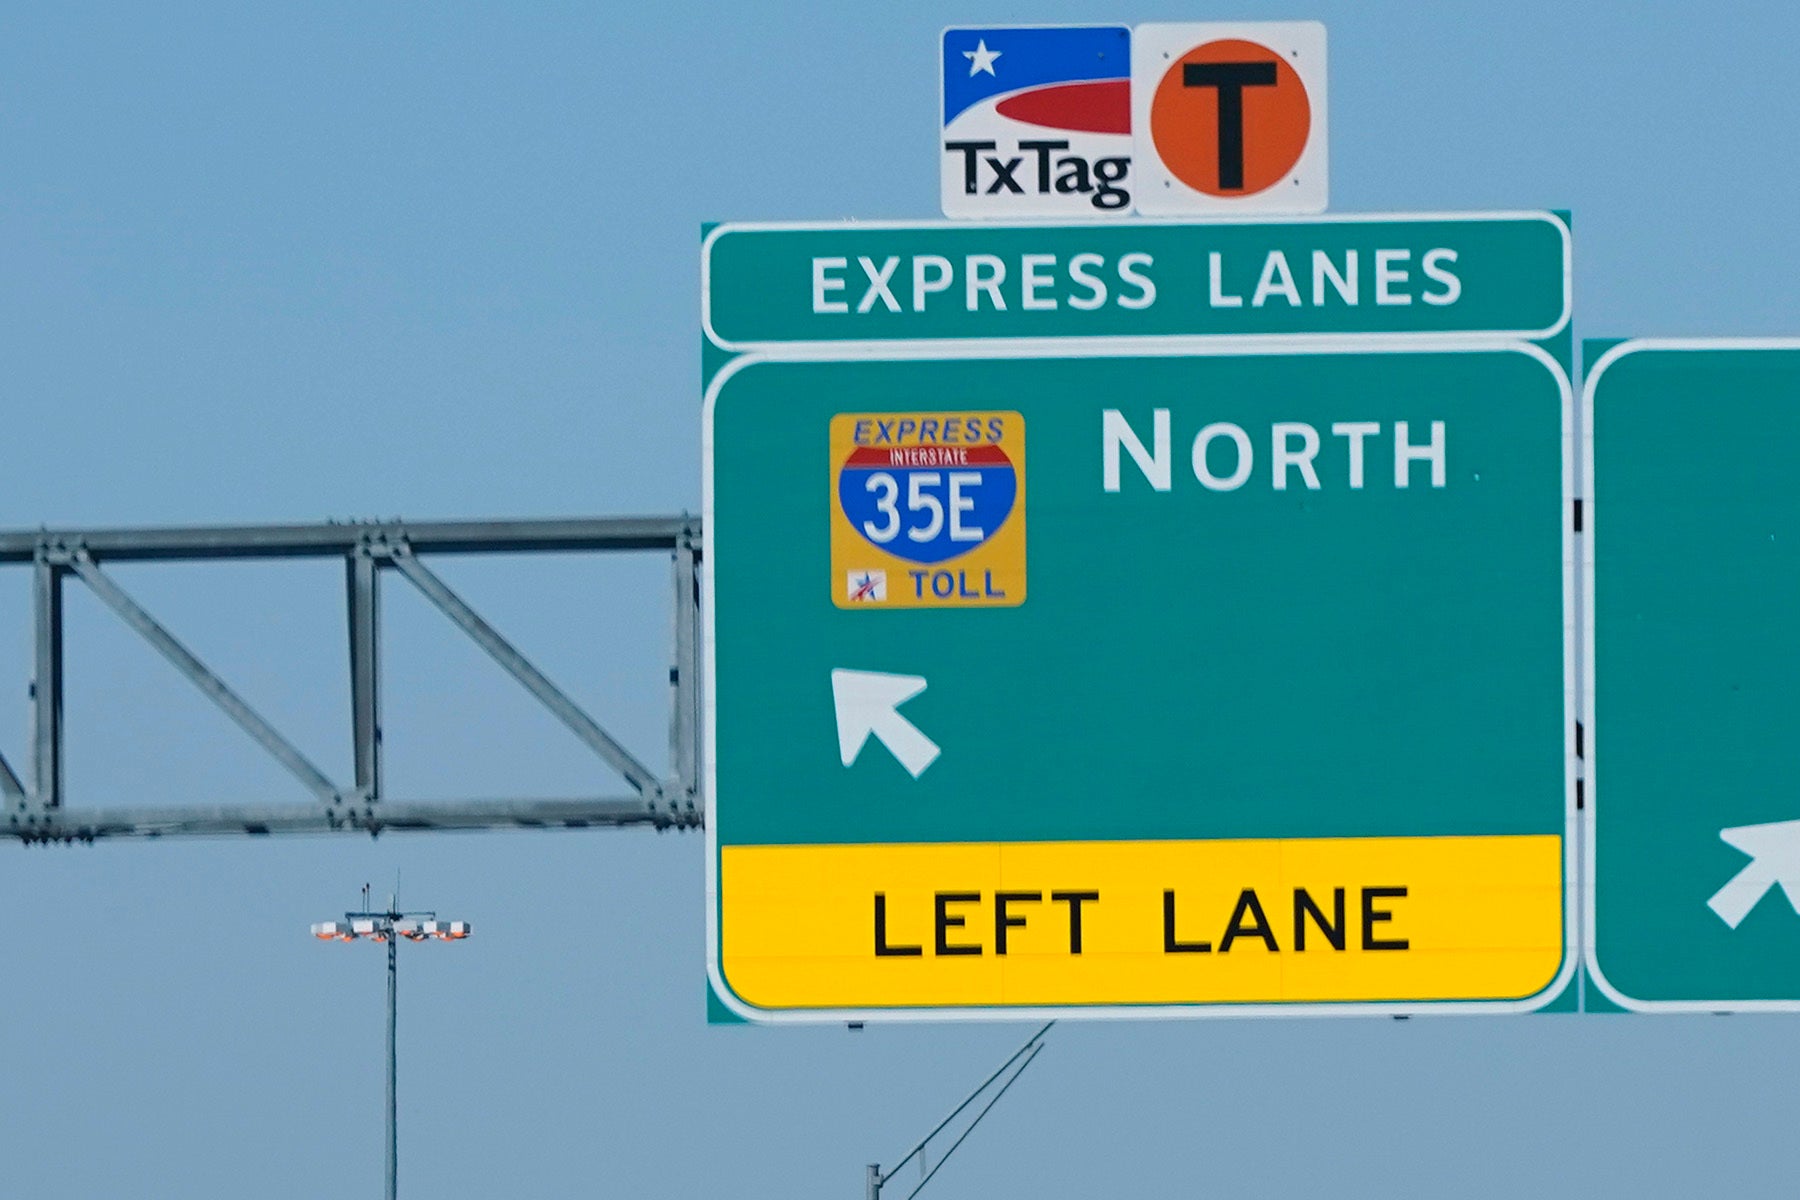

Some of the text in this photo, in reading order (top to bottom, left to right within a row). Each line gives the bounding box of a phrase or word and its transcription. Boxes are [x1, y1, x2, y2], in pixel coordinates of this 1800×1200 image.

[1182, 61, 1278, 190] T
[944, 139, 1132, 210] TxTag
[811, 248, 1463, 314] EXPRESS LANES
[853, 417, 1004, 445] EXPRESS
[889, 447, 968, 466] INTERSTATE
[1102, 408, 1449, 494] NORTH
[863, 471, 984, 544] 35E
[908, 568, 1006, 599] TOLL
[873, 886, 1411, 957] LEFT LANE
